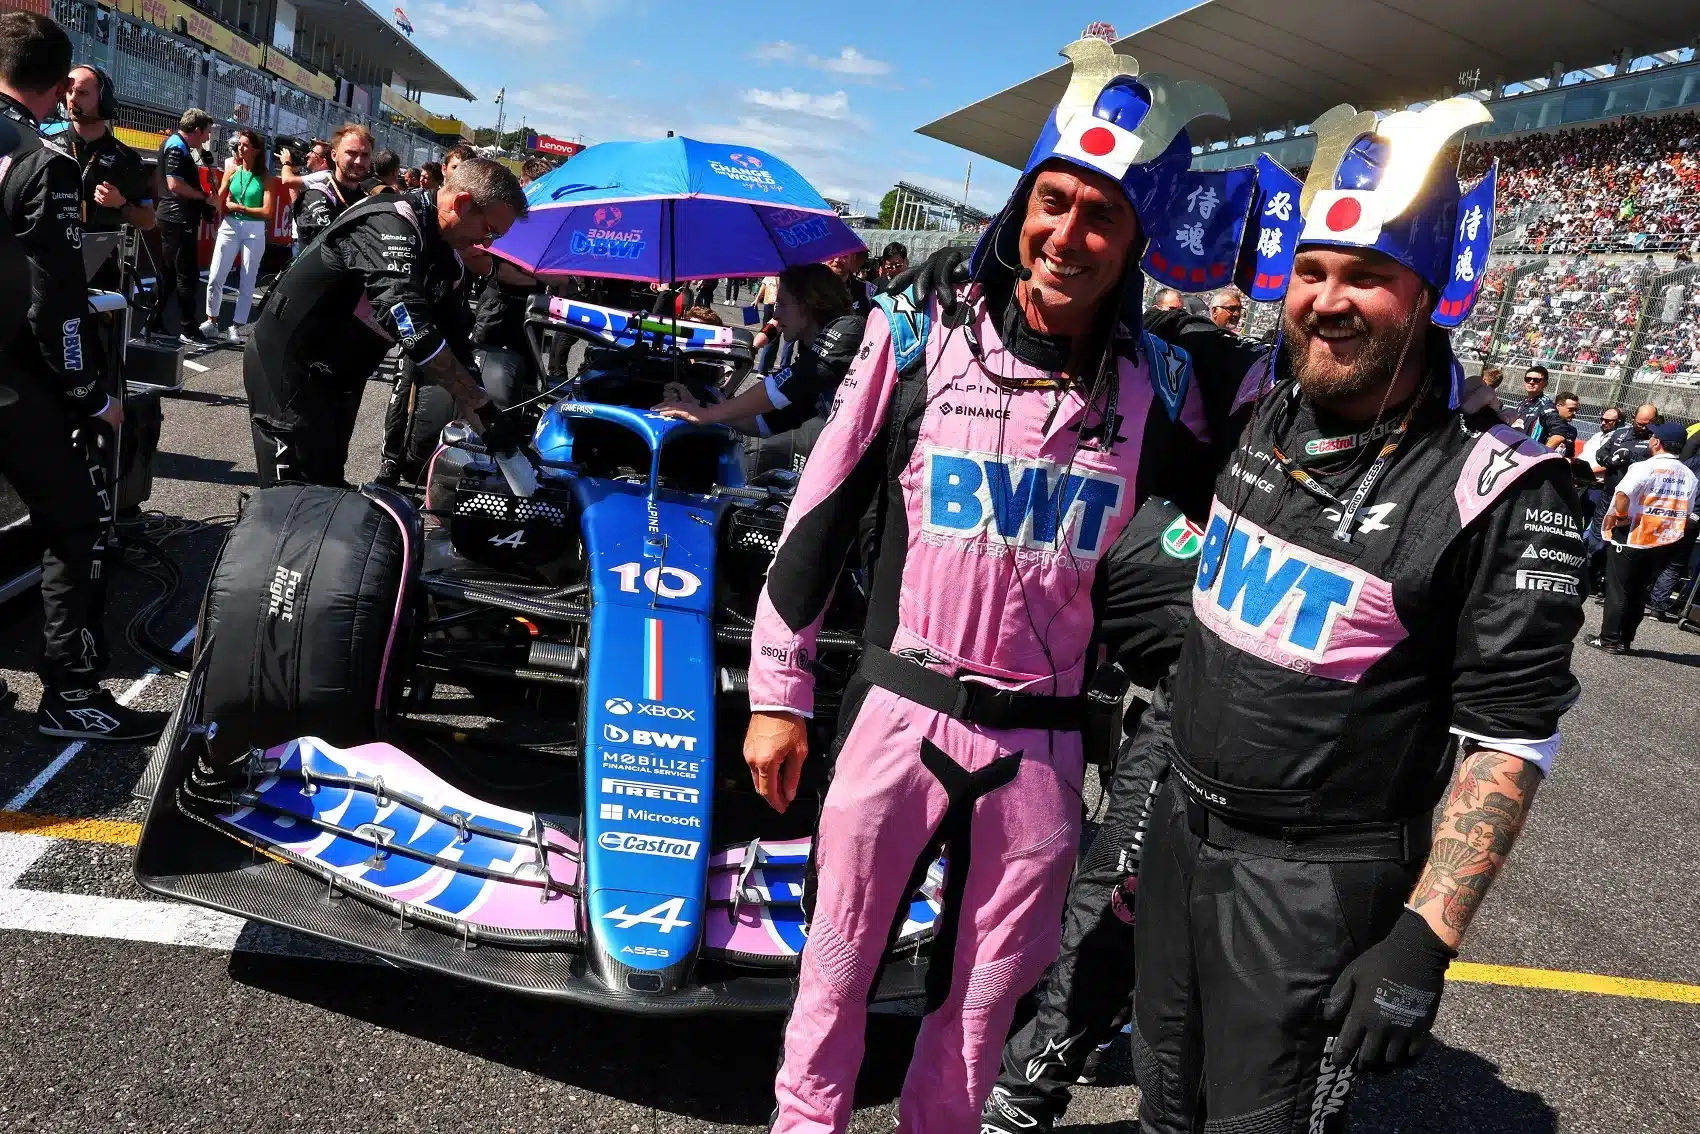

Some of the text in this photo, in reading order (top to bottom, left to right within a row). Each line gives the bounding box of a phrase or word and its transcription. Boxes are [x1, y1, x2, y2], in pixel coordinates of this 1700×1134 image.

[540, 140, 573, 153] Lenovo
[711, 163, 772, 178] CHANGE
[726, 172, 776, 185] WORLD
[1254, 190, 1293, 259] 必勝
[590, 238, 646, 260] BWT
[1455, 204, 1484, 283] 侍魂
[390, 301, 417, 338] BWT
[63, 334, 83, 371] BWT
[941, 382, 1014, 396] ALPINE
[577, 404, 594, 414] PASS
[955, 405, 1011, 420] BINANCE
[1319, 435, 1354, 452] Castrol
[1347, 458, 1384, 514] GRID ACCESS
[930, 454, 1120, 552] BWT
[1524, 523, 1565, 537] FINANCIAL
[1525, 508, 1578, 531] MØBIL
[921, 532, 952, 548] BEST
[268, 565, 290, 617] Right
[608, 562, 702, 599] 10
[1199, 513, 1355, 651] BWT
[1515, 569, 1580, 596] PIRELLI
[281, 570, 302, 623] Front
[637, 703, 696, 721] XBOX
[633, 729, 698, 752] BWT
[602, 762, 697, 779] FINANCIAL SERVICES
[601, 777, 700, 804] PIRELLI
[628, 808, 701, 828] Microsoft
[218, 748, 525, 914] BWT
[623, 836, 692, 857] Castrol
[620, 945, 670, 958] A523
